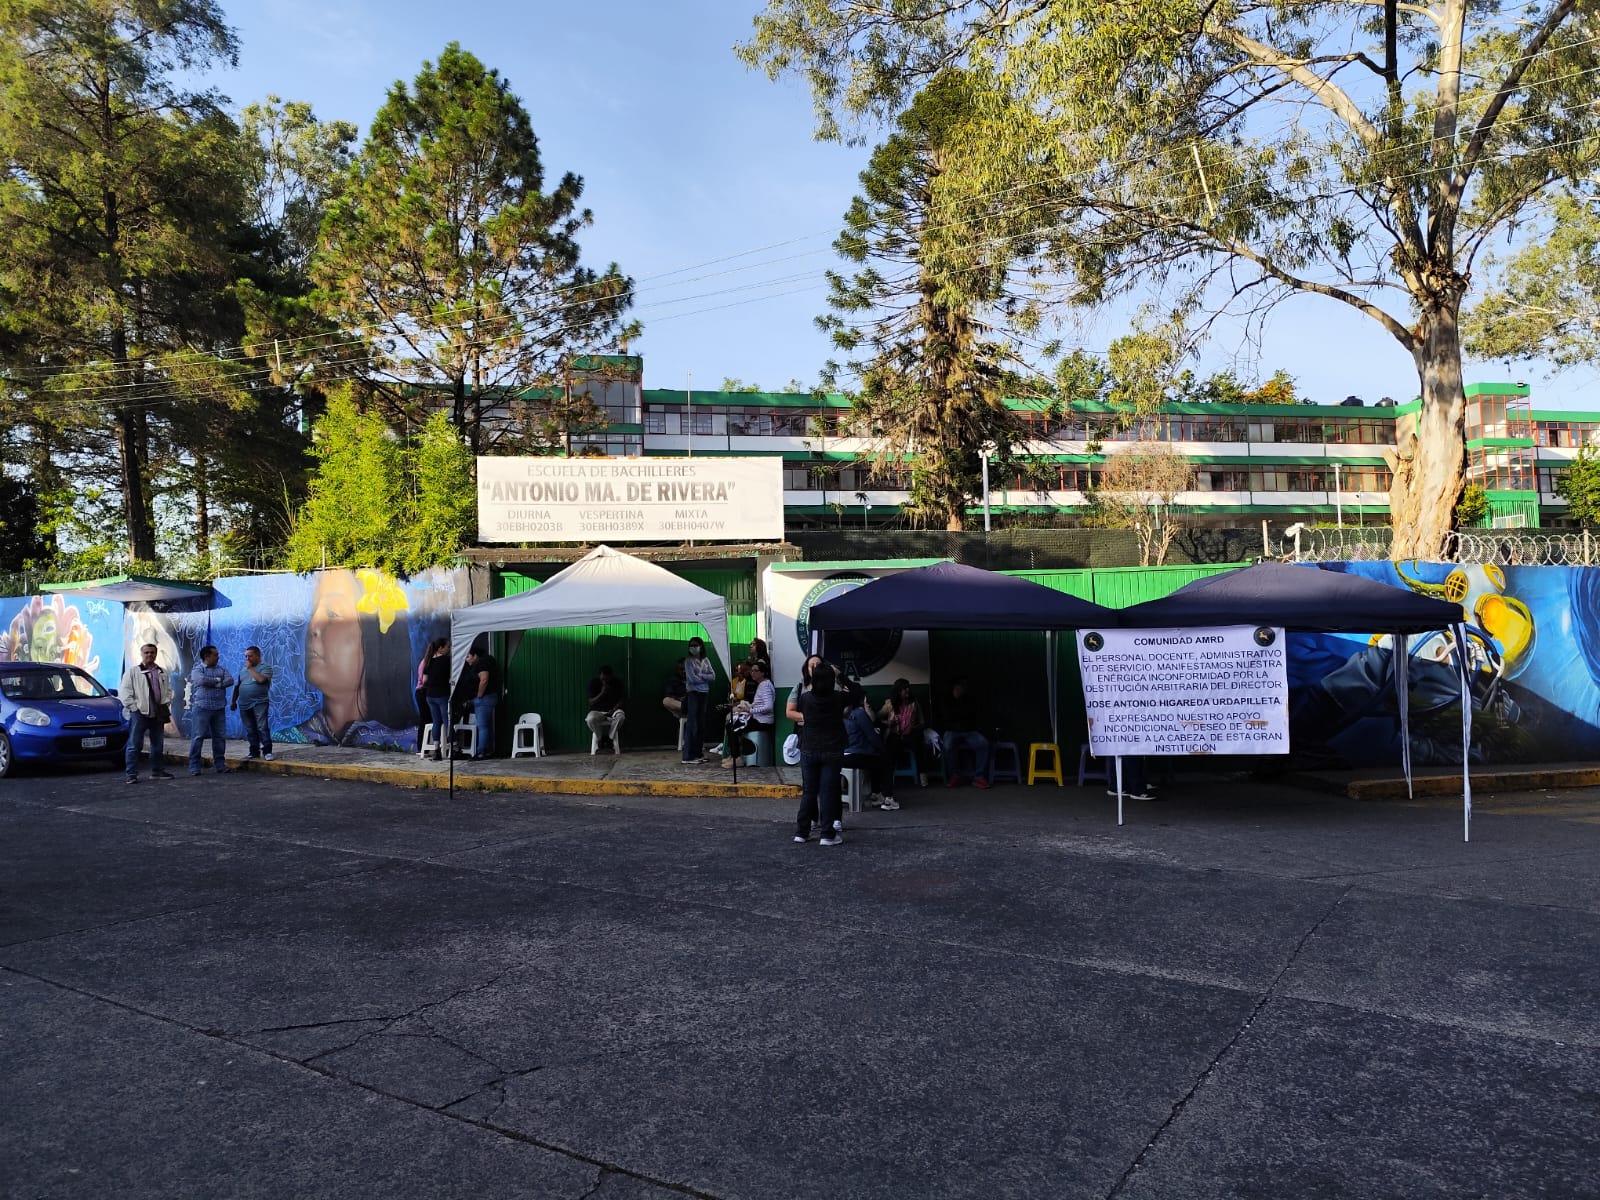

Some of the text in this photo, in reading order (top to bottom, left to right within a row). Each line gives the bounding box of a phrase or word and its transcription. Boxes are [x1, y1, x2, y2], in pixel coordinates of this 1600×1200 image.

[528, 465, 696, 477] ESCUELA DE BACHILLERES
[585, 481, 620, 501] MA.
[627, 481, 652, 501] DE
[508, 509, 707, 519] DIURNA VESPERTINA MIXTA
[580, 521, 644, 531] 30EBH0389X
[1134, 636, 1224, 645] COMUNIDAD AMRD
[1096, 654, 1146, 662] PERSONAL
[1149, 653, 1198, 661] DOCENTE,
[1200, 650, 1281, 659] ADMINISTRATIVO
[1107, 664, 1154, 672] SERVICIO,
[1157, 662, 1233, 670] MANIFESTAMOS
[1237, 660, 1282, 669] NUESTRA
[1149, 672, 1230, 680] INCONFORMIDAD
[1086, 681, 1282, 692] DESTITUCIÓN ARBITRARIA DEL DIRECTOR
[1114, 700, 1157, 708] ANTONIO
[1177, 713, 1224, 721] NUESTRO
[1226, 712, 1260, 720] APOYO
[1104, 724, 1181, 732] INCONDICIONAL
[1193, 723, 1226, 731] DESEO
[1230, 723, 1242, 731] DE
[1092, 734, 1140, 743] CONTINÚE
[1167, 734, 1205, 742] CABEZA
[1156, 743, 1216, 752] INSTITUCIÓN
